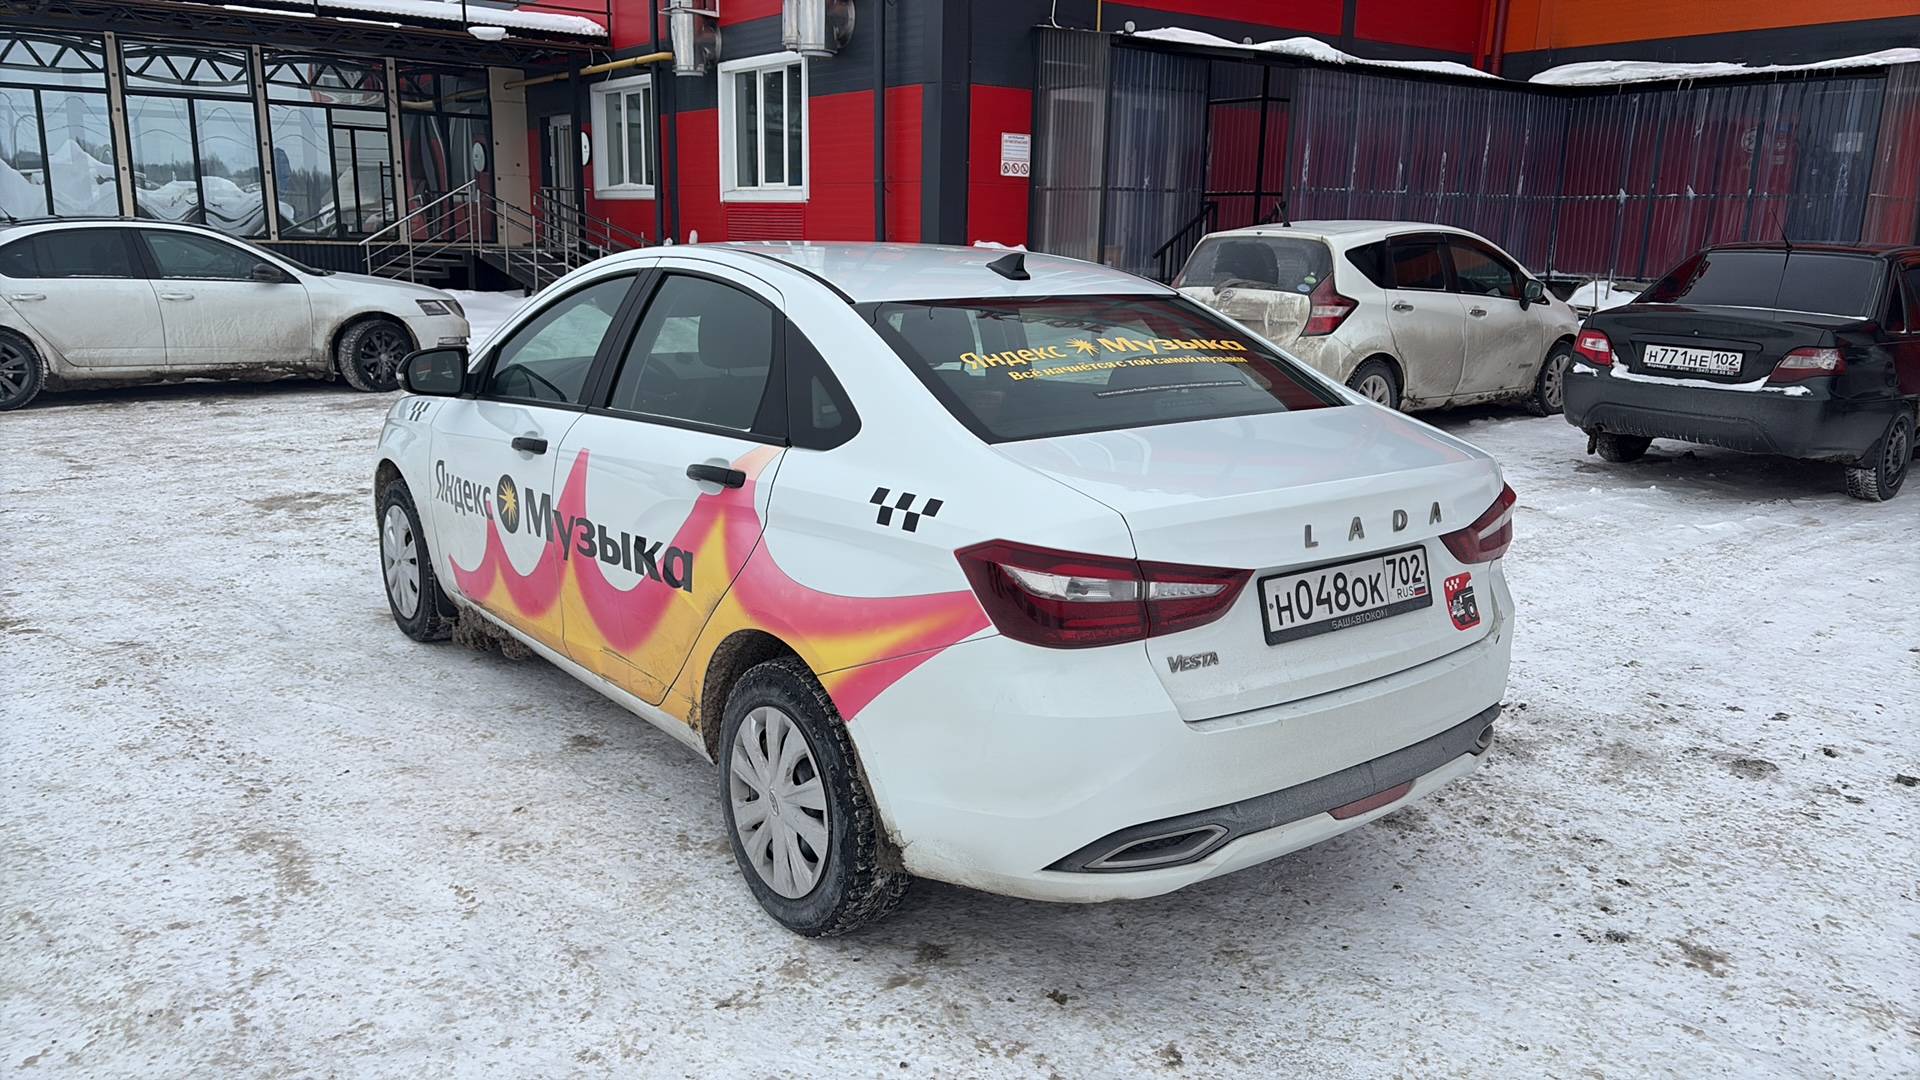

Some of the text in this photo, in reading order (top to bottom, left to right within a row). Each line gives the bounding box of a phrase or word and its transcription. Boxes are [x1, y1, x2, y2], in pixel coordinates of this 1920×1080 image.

[959, 335, 1248, 371] Яндекс Музыка
[1008, 368, 1043, 381] Всё
[1043, 361, 1117, 376] начнётся
[1126, 357, 1154, 367] той
[1153, 355, 1196, 365] самой
[1713, 353, 1738, 366] 102
[436, 460, 694, 593] Яндекс Музыка
[1304, 501, 1442, 548] LADA
[1386, 554, 1422, 588] 702
[1397, 586, 1414, 598] RUS
[1167, 651, 1219, 674] VESTA
